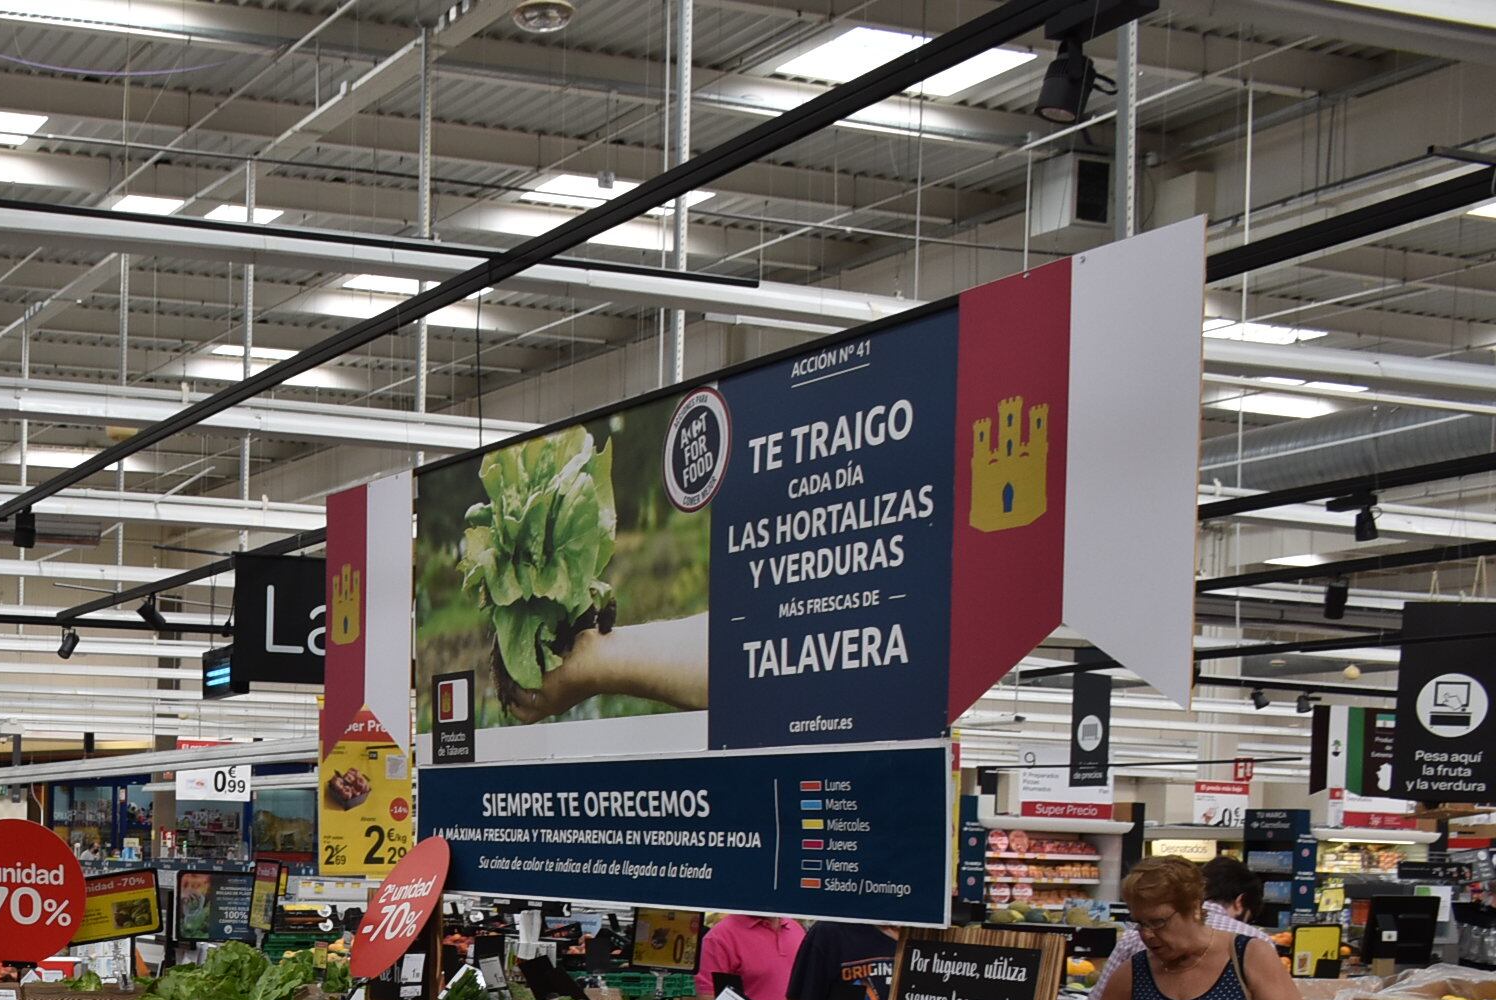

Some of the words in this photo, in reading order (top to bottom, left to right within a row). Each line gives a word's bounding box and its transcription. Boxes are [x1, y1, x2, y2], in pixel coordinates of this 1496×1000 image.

[790, 348, 836, 378] ACCIÓN
[856, 339, 871, 357] 41
[748, 431, 783, 474] TE
[790, 399, 914, 464] TRAIGO
[684, 434, 707, 466] FOR
[682, 451, 714, 489] FOOD
[788, 472, 832, 500] CADA
[835, 460, 864, 490] DÍA
[728, 517, 770, 554] LAS
[776, 484, 934, 545] HORTALIZAS
[749, 558, 765, 589] Y
[769, 534, 905, 586] VERDURAS
[778, 597, 804, 618] MÁS
[806, 592, 860, 614] FRESCAS
[862, 590, 880, 607] DE
[743, 623, 909, 679] TALAVERA
[789, 715, 853, 733] carrefour.es
[440, 732, 466, 743] Producto
[437, 747, 446, 757] de
[446, 745, 469, 756] Talavera
[1024, 751, 1036, 769] 9
[1414, 749, 1449, 761] Pesa
[1450, 750, 1484, 766] aquí
[1422, 763, 1435, 777] la
[1436, 764, 1472, 778] fruta
[824, 779, 852, 792] Lunes
[1405, 779, 1415, 792] y
[1416, 777, 1429, 790] la
[1430, 779, 1487, 793] verdura
[482, 792, 555, 818] SIEMPRE
[556, 791, 579, 818] TE
[584, 789, 711, 818] OFRECEMOS
[825, 798, 858, 811] Martes
[1034, 802, 1064, 816] Super
[1066, 803, 1099, 816] Precio
[826, 817, 871, 832] Miércoles
[445, 824, 482, 841] MÁXIMA
[483, 828, 530, 843] FRESCURA
[531, 829, 539, 843] Y
[540, 829, 623, 846] TRANSPARENCIA
[625, 831, 641, 846] EN
[643, 830, 706, 848] VERDURAS
[708, 832, 725, 848] DE
[727, 832, 762, 849] HOJA
[826, 838, 858, 851] Jueves
[478, 856, 490, 869] Su
[490, 856, 510, 870] cinta
[511, 856, 522, 871] de
[522, 858, 545, 872] color
[545, 860, 555, 872] te
[555, 858, 581, 873] indica
[582, 860, 592, 874] el
[593, 858, 607, 875] día
[608, 860, 621, 876] de
[621, 861, 658, 880] llegada
[659, 865, 666, 877] a
[667, 862, 678, 878] la
[679, 862, 712, 880] tienda
[825, 858, 859, 873] Viernes
[116, 875, 146, 889] -70%
[391, 873, 438, 901] unidad
[824, 877, 857, 893] Sábado
[865, 880, 912, 898] Domingo
[223, 910, 249, 921] 100%
[361, 901, 425, 942] -70%
[840, 962, 893, 982] ORIGIN
[910, 948, 930, 973] Por
[931, 951, 980, 982] higiene,
[984, 956, 1028, 982] utiliza
